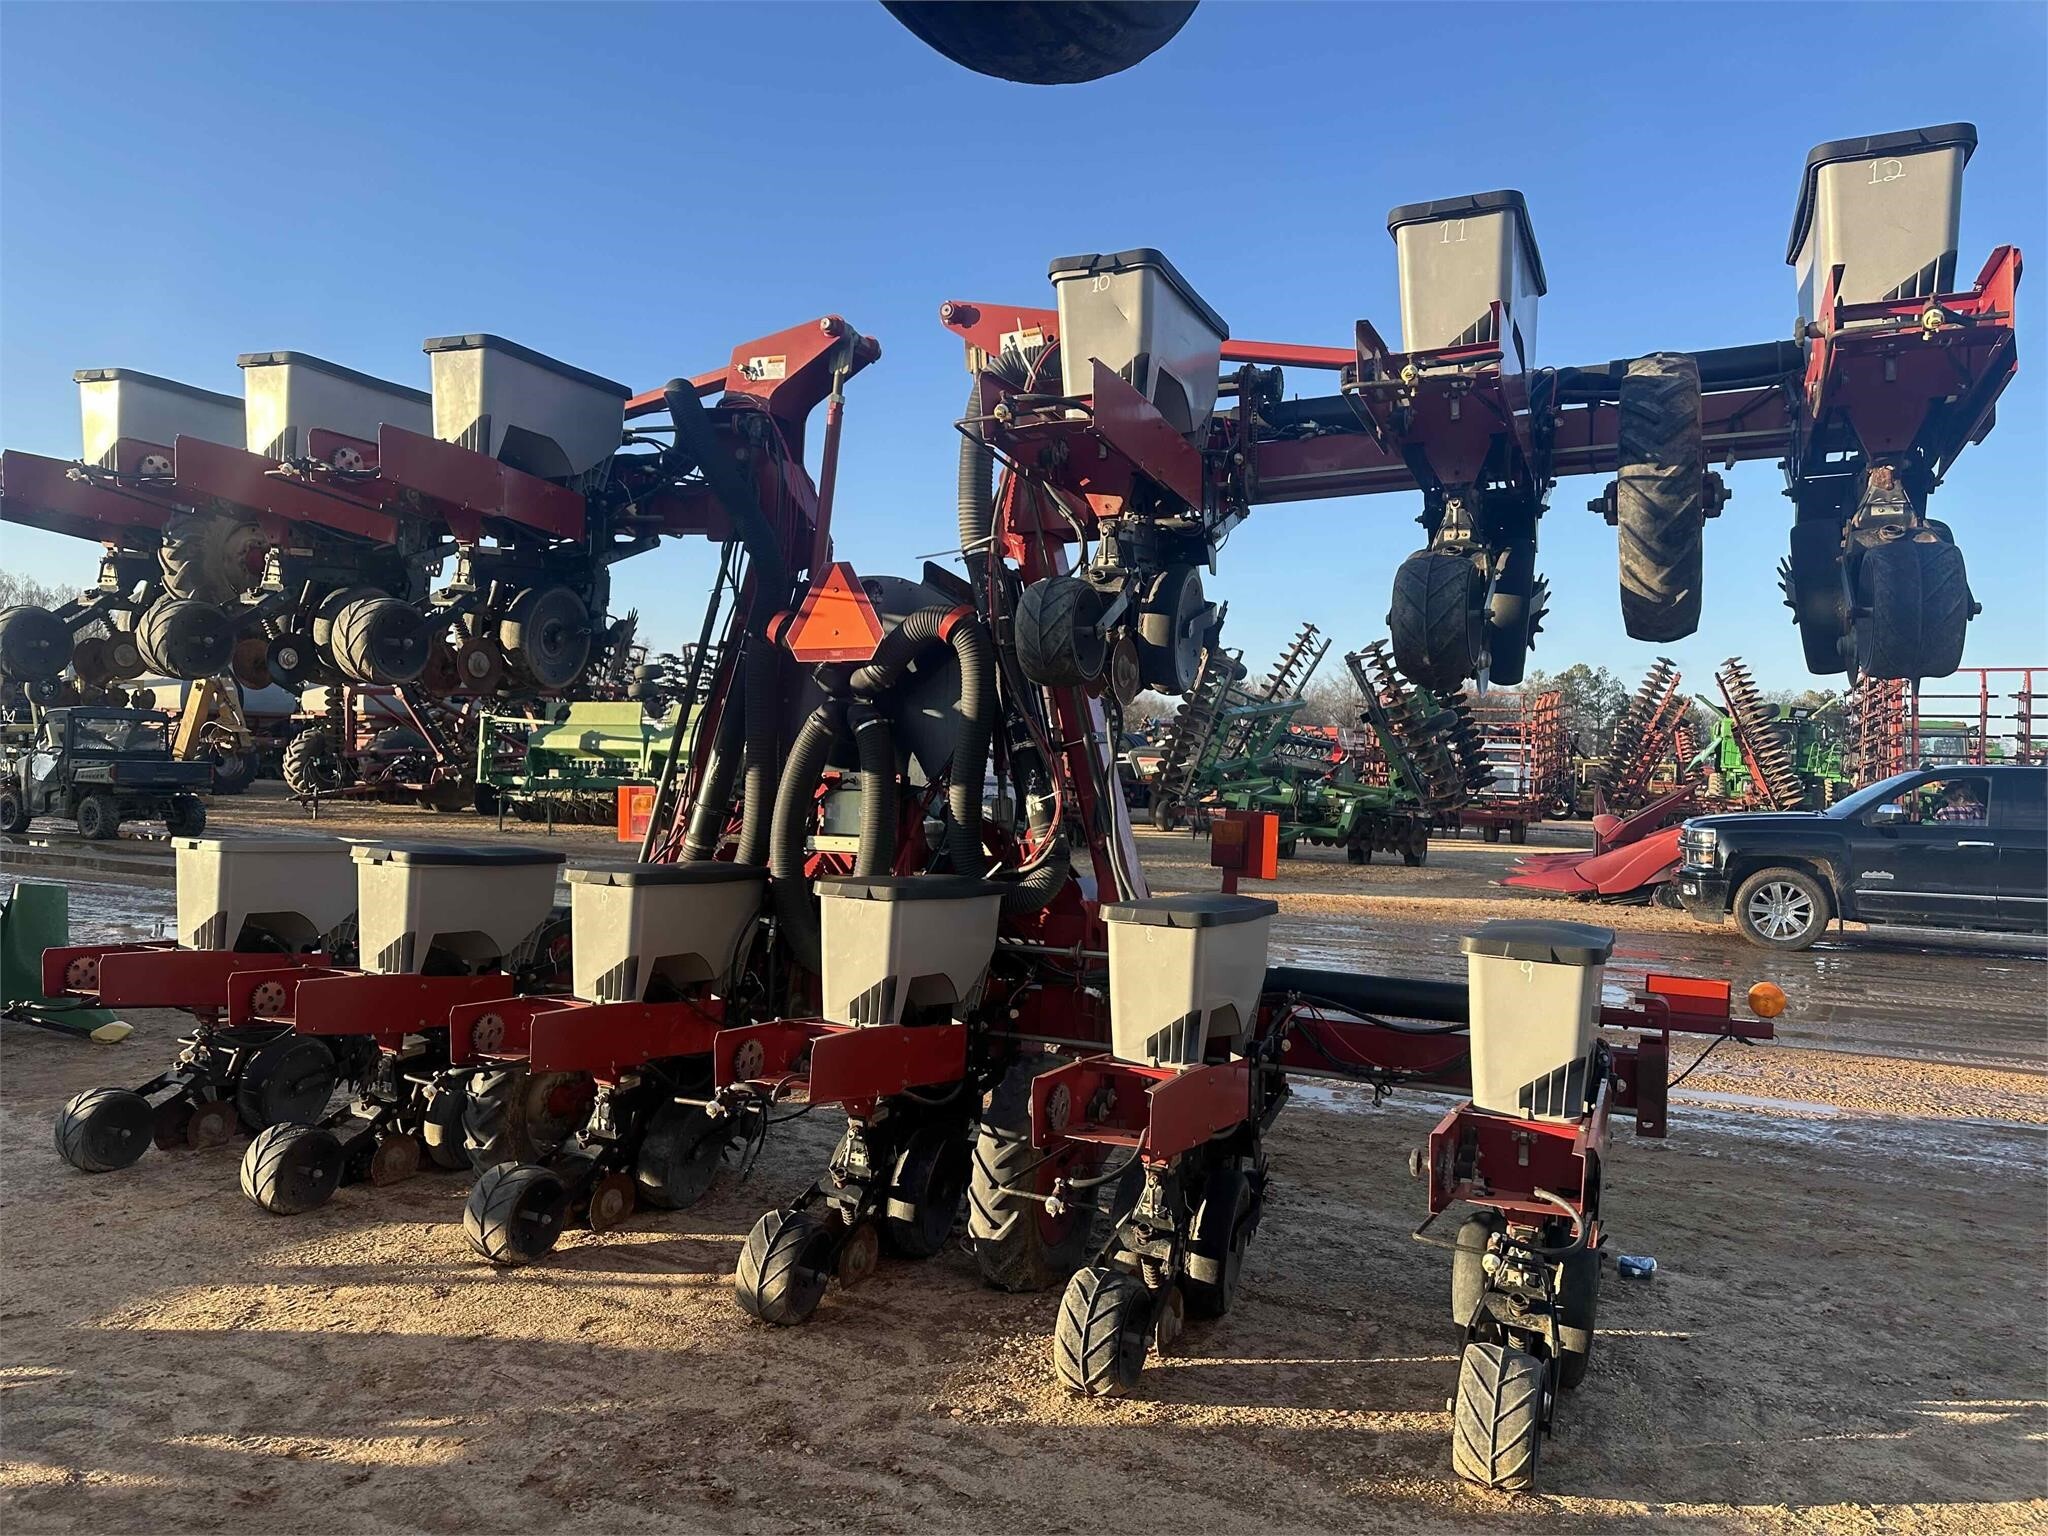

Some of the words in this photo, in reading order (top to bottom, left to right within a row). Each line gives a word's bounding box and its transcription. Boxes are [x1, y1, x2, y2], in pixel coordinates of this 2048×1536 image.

[1868, 159, 1906, 184] 12
[1439, 218, 1468, 244] 11
[1092, 275, 1110, 293] 10
[601, 887, 609, 904] 6
[1145, 927, 1154, 943] 8
[1520, 960, 1534, 983] 9
